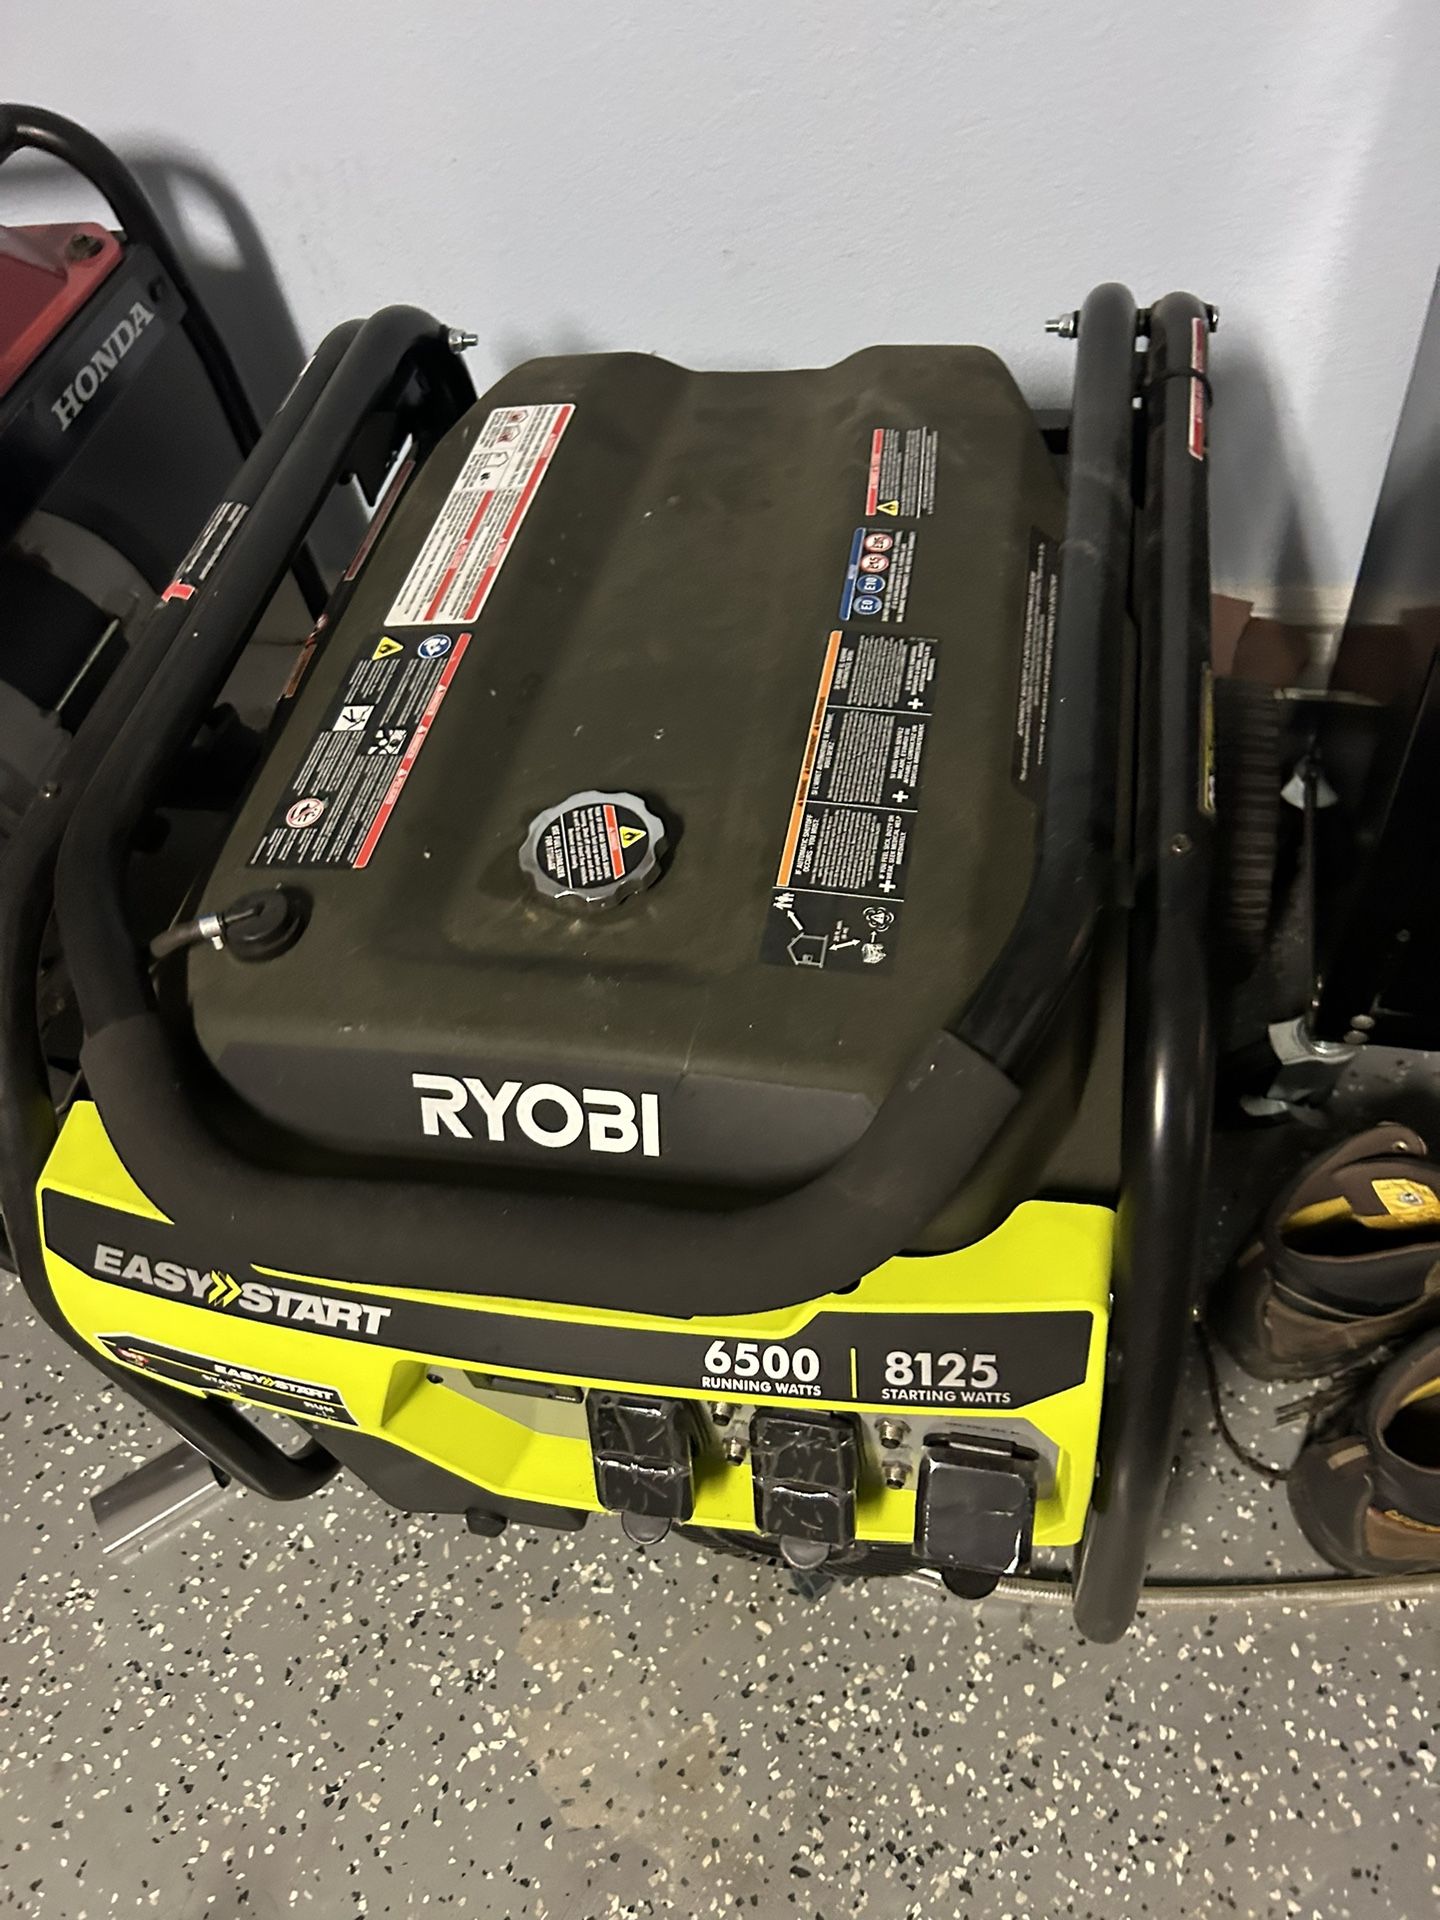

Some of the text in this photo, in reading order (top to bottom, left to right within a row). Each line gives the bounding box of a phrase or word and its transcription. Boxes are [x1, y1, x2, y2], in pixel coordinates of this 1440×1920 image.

[51, 302, 155, 432] HONDA
[864, 576, 877, 591] E10
[412, 1073, 660, 1157] RYOBI
[94, 1244, 392, 1335] EASY START
[704, 1340, 820, 1382] 6500
[885, 1351, 998, 1388] 8125
[214, 1364, 333, 1400] EASY START
[702, 1376, 822, 1396] RUNNING WATTS
[881, 1388, 1011, 1403] STARTING WATTS
[303, 1401, 335, 1414] RUN
